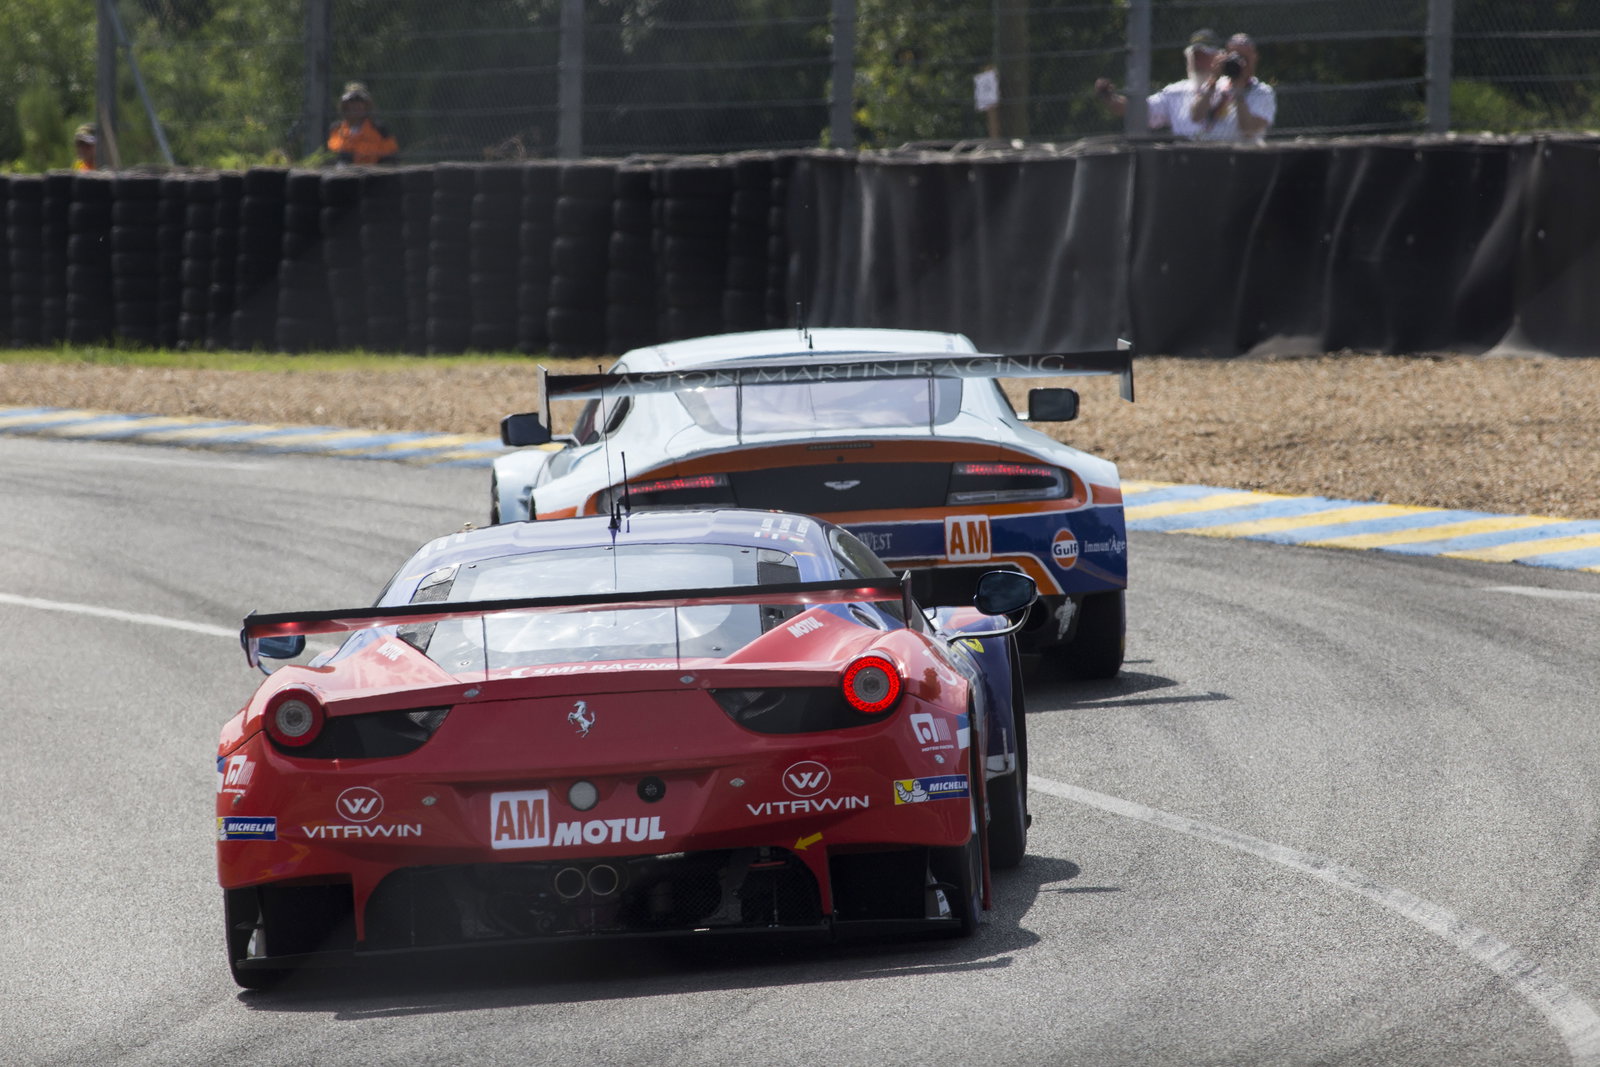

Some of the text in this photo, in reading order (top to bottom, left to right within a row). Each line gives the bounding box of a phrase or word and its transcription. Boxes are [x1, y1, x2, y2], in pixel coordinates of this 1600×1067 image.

[611, 354, 1064, 393] ASTON MARTIN RACING
[950, 520, 989, 555] AM
[1053, 543, 1078, 556] Gulf
[786, 616, 824, 638] MOTUL
[532, 663, 678, 675] SMP RACING
[929, 781, 968, 792] MICHELIN
[746, 795, 870, 815] VITAWIN
[227, 823, 275, 832] MICHELIN
[494, 799, 545, 841] AM
[301, 823, 422, 838] VITAWIN
[552, 816, 666, 847] MOTUL
